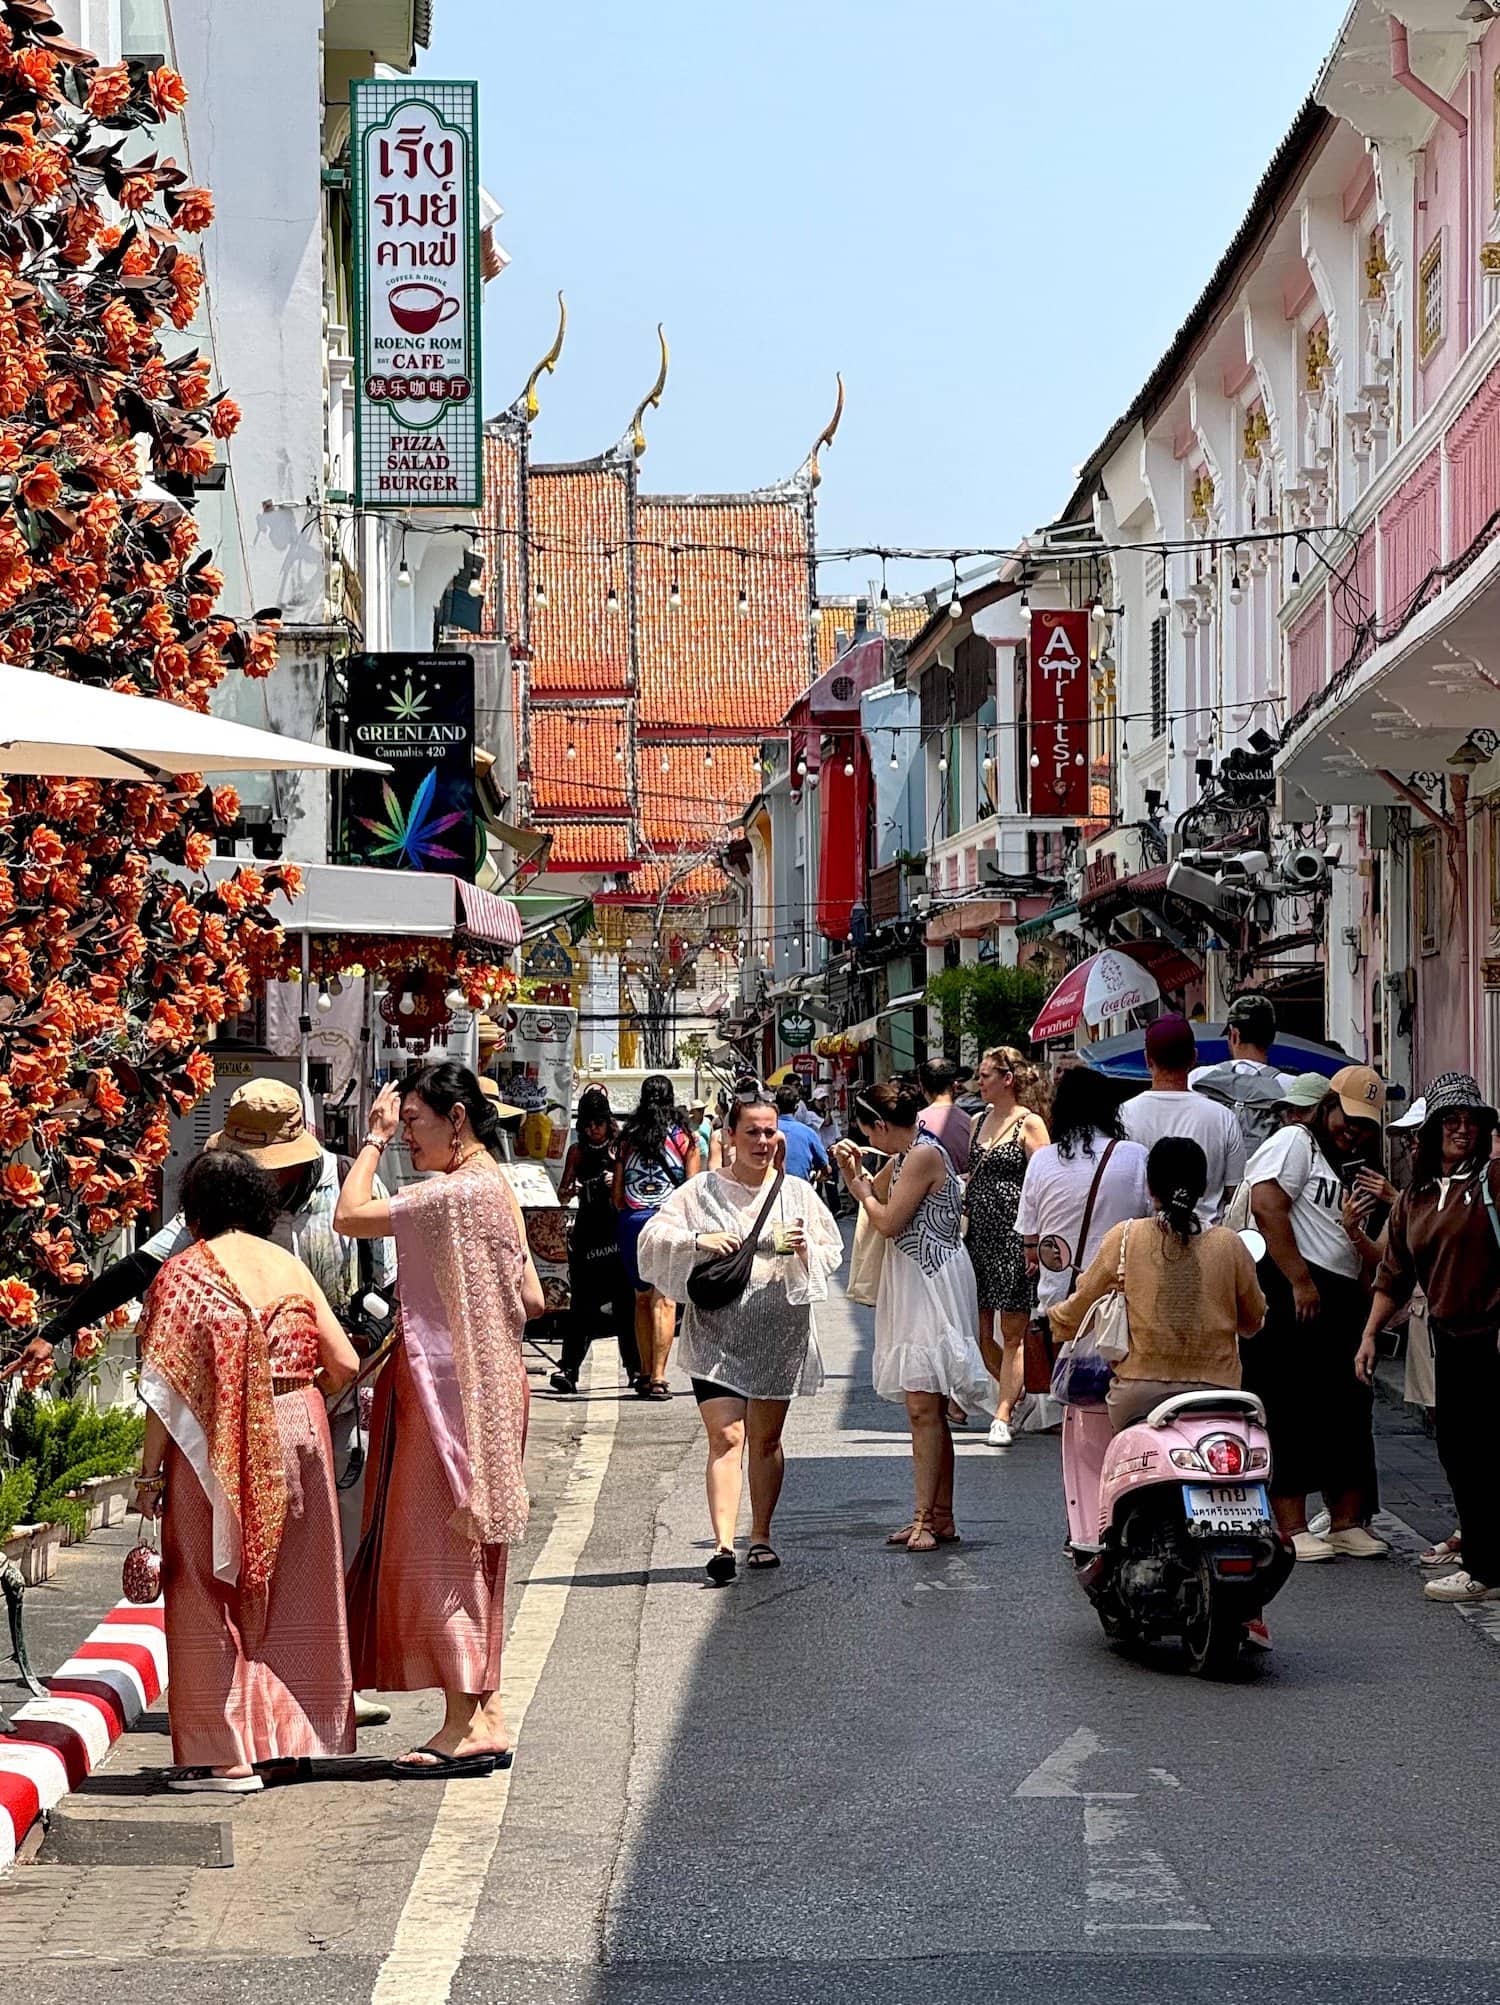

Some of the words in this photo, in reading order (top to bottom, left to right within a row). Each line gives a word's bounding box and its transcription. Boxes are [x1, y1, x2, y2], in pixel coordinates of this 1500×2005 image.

[374, 181, 457, 228] รมย์
[377, 232, 456, 267] คาเฟ่
[385, 274, 413, 286] COFFEE
[423, 274, 448, 287] DRINK
[374, 338, 425, 350] ROENG
[430, 338, 463, 350] ROM
[392, 354, 445, 369] CAFE
[369, 379, 466, 397] 娱乐咖啡厅
[391, 436, 445, 450] PIZZA
[387, 455, 450, 470] SALAD
[379, 476, 458, 490] BURGER
[356, 725, 467, 741] GREENLAND
[375, 746, 423, 757] Cannabis
[426, 746, 446, 757] 420
[1366, 1083, 1378, 1100] B
